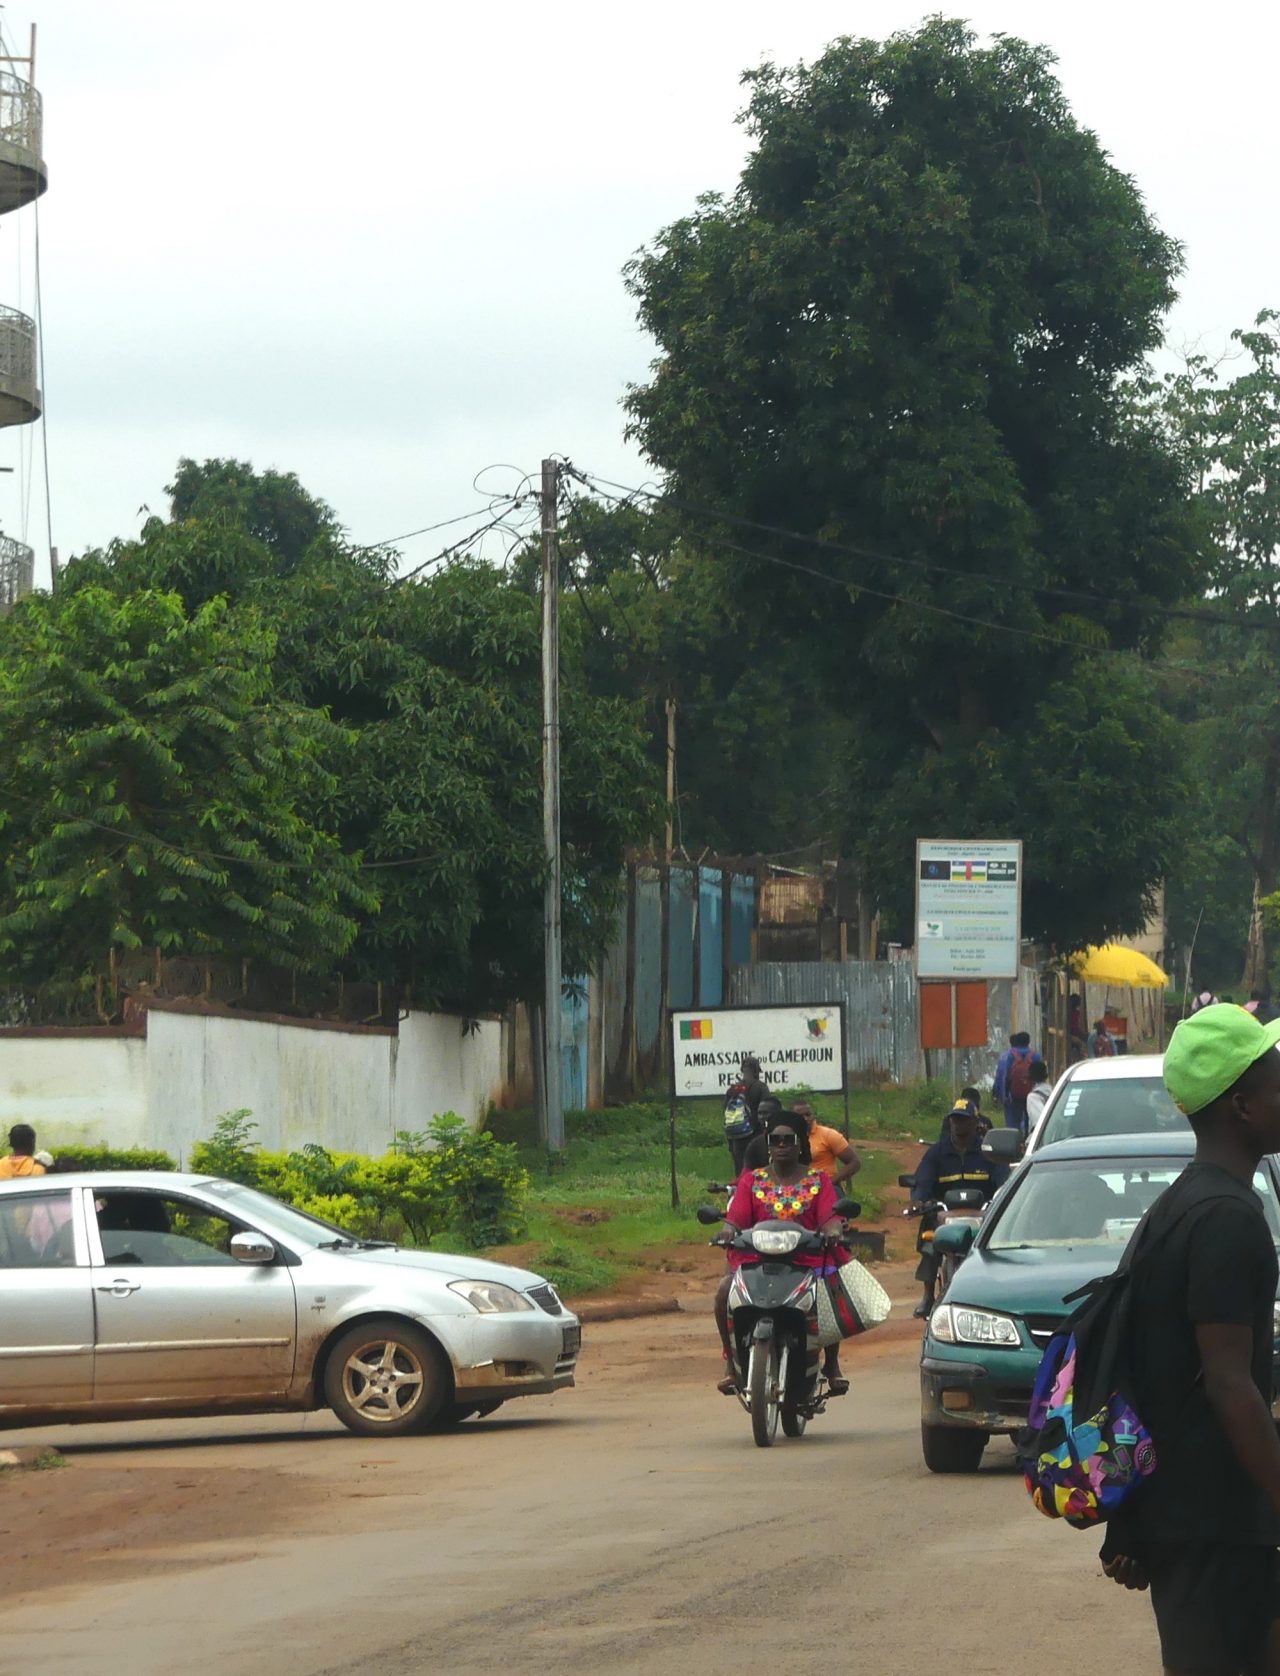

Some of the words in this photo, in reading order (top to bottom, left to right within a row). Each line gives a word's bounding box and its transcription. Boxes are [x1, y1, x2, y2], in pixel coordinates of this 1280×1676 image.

[757, 1056, 767, 1064] DU
[769, 1048, 834, 1063] CAMEROUN
[718, 1070, 789, 1087] RESNCE
